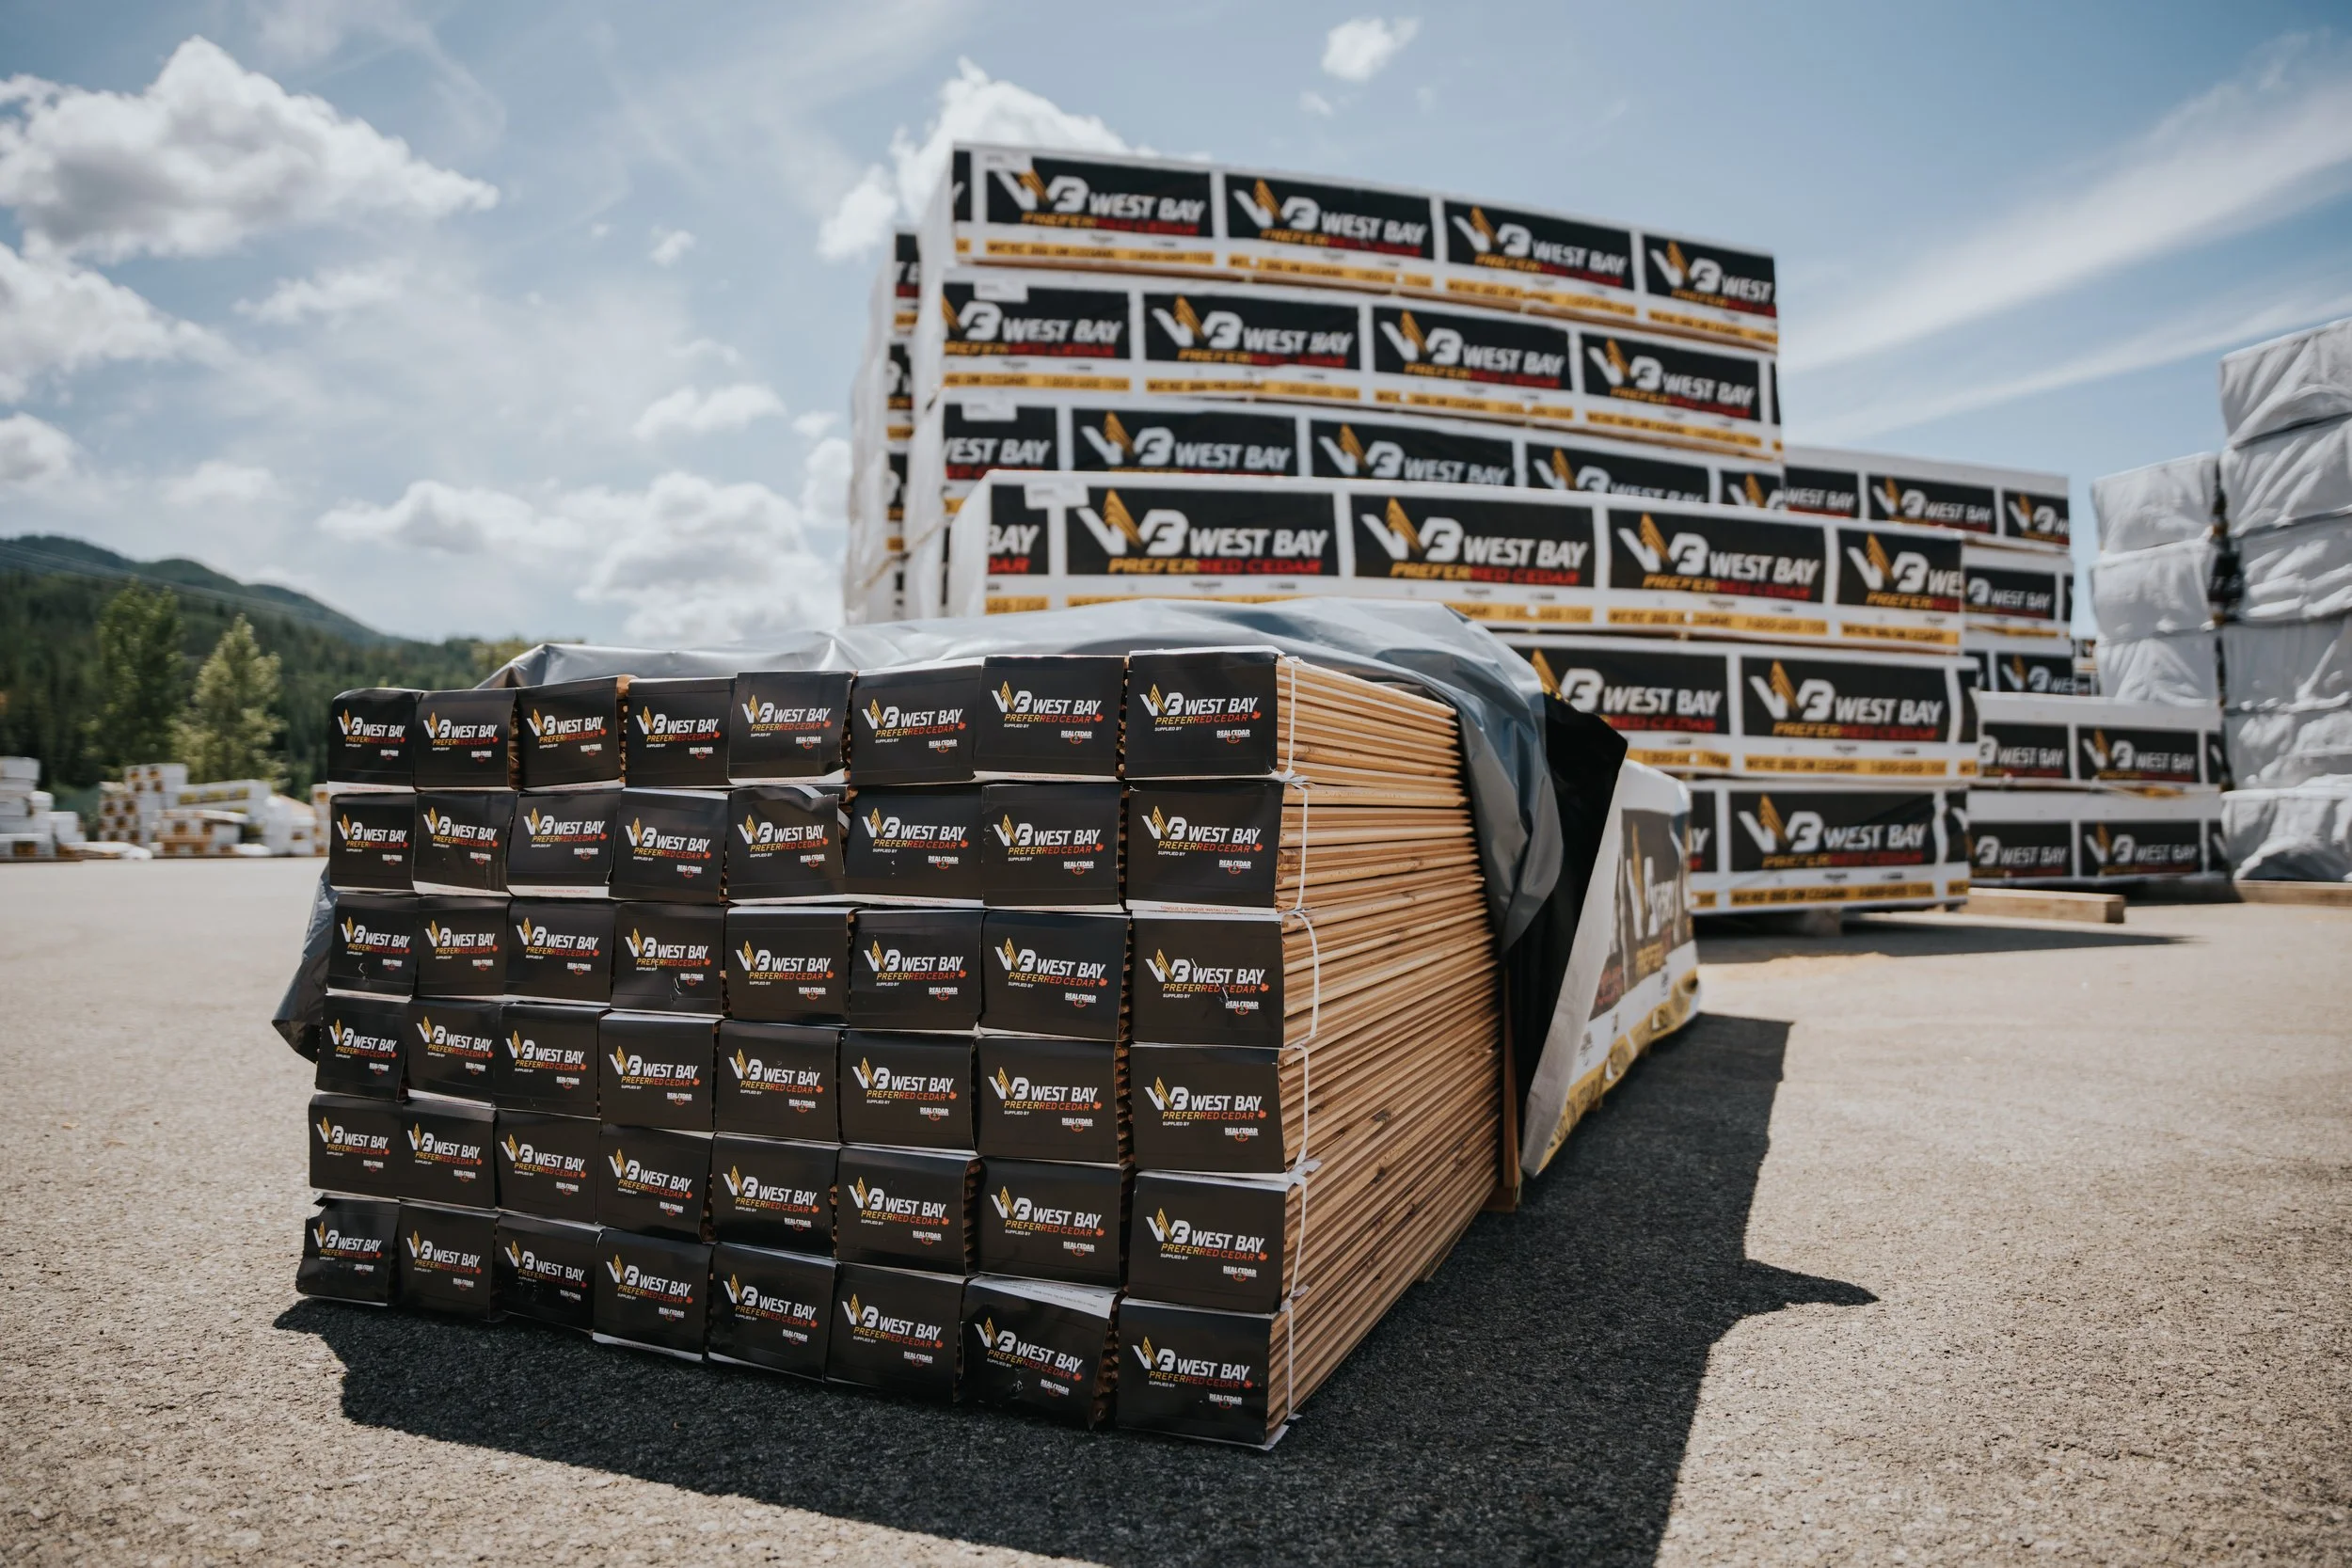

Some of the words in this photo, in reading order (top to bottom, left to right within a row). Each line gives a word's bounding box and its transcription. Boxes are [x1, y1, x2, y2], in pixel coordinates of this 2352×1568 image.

[1089, 193, 1153, 219] WEST
[1157, 198, 1206, 221] BAY
[1320, 213, 1383, 237] WEST
[1385, 220, 1427, 245] BAY
[1531, 241, 1587, 265] WEST
[1587, 249, 1628, 275] BAY
[1002, 318, 1073, 342] WEST
[1074, 319, 1122, 343] BAY
[1243, 327, 1306, 352] WEST
[1309, 331, 1353, 354] BAY
[1463, 344, 1525, 372] WEST
[1523, 352, 1565, 376] BAY
[1661, 373, 1715, 400] WEST
[1716, 383, 1756, 407] BAY
[1000, 438, 1050, 464] BAY
[1175, 442, 1242, 467] WEST
[1245, 445, 1291, 468] BAY
[1189, 529, 1270, 556] WEST
[1273, 530, 1327, 557] BAY
[1464, 536, 1536, 566] WEST
[1536, 540, 1587, 569] BAY
[1708, 550, 1775, 579] WEST
[1776, 557, 1819, 585] BAY
[1033, 699, 1072, 714] WEST
[1073, 700, 1102, 715] BAY
[1185, 698, 1226, 715] WEST
[1228, 697, 1259, 713] BAY
[1603, 687, 1675, 714] WEST
[1677, 689, 1722, 716] BAY
[1836, 696, 1898, 723] WEST
[1898, 699, 1943, 724] BAY
[668, 720, 696, 734] WEST
[697, 719, 719, 733] BAY
[901, 711, 936, 727] WEST
[937, 708, 962, 724] BAY
[363, 723, 388, 736] WEST
[388, 725, 405, 737] BAY
[554, 822, 583, 834] WEST
[583, 821, 605, 833] BAY
[774, 827, 805, 842] WEST
[807, 825, 828, 840] BAY
[901, 825, 938, 840] WEST
[939, 826, 966, 841] BAY
[1035, 831, 1072, 846] WEST
[1073, 830, 1101, 845] BAY
[1189, 825, 1231, 843] WEST
[1231, 828, 1262, 845] BAY
[1823, 824, 1884, 850] WEST
[1887, 823, 1928, 849] BAY
[772, 958, 805, 972] WEST
[807, 958, 831, 973] BAY
[902, 957, 937, 972] WEST
[938, 957, 963, 972] BAY
[1038, 958, 1076, 976] WEST
[1076, 962, 1106, 979] BAY
[1193, 967, 1233, 984] WEST
[1236, 969, 1265, 985] BAY
[447, 1033, 472, 1049] WEST
[473, 1037, 492, 1053] BAY
[644, 1063, 674, 1078] WEST
[675, 1065, 698, 1080] BAY
[892, 1075, 927, 1091] WEST
[929, 1077, 954, 1093] BAY
[1031, 1085, 1069, 1101] WEST
[1071, 1087, 1098, 1102] BAY
[1191, 1095, 1232, 1111] WEST
[1234, 1096, 1263, 1111] BAY
[759, 1185, 792, 1202] WEST
[793, 1190, 817, 1206] BAY
[886, 1197, 920, 1214] WEST
[921, 1201, 946, 1218] BAY
[1034, 1207, 1073, 1226] WEST
[1073, 1212, 1102, 1229] BAY
[1192, 1229, 1233, 1249] WEST
[1234, 1235, 1265, 1253] BAY
[640, 1274, 669, 1292] WEST
[669, 1281, 691, 1297] BAY
[880, 1316, 914, 1336] WEST
[914, 1323, 942, 1341] BAY
[1016, 1340, 1055, 1365] WEST
[1054, 1353, 1084, 1372] BAY
[1178, 1358, 1218, 1377] WEST
[1220, 1363, 1250, 1382] BAY
